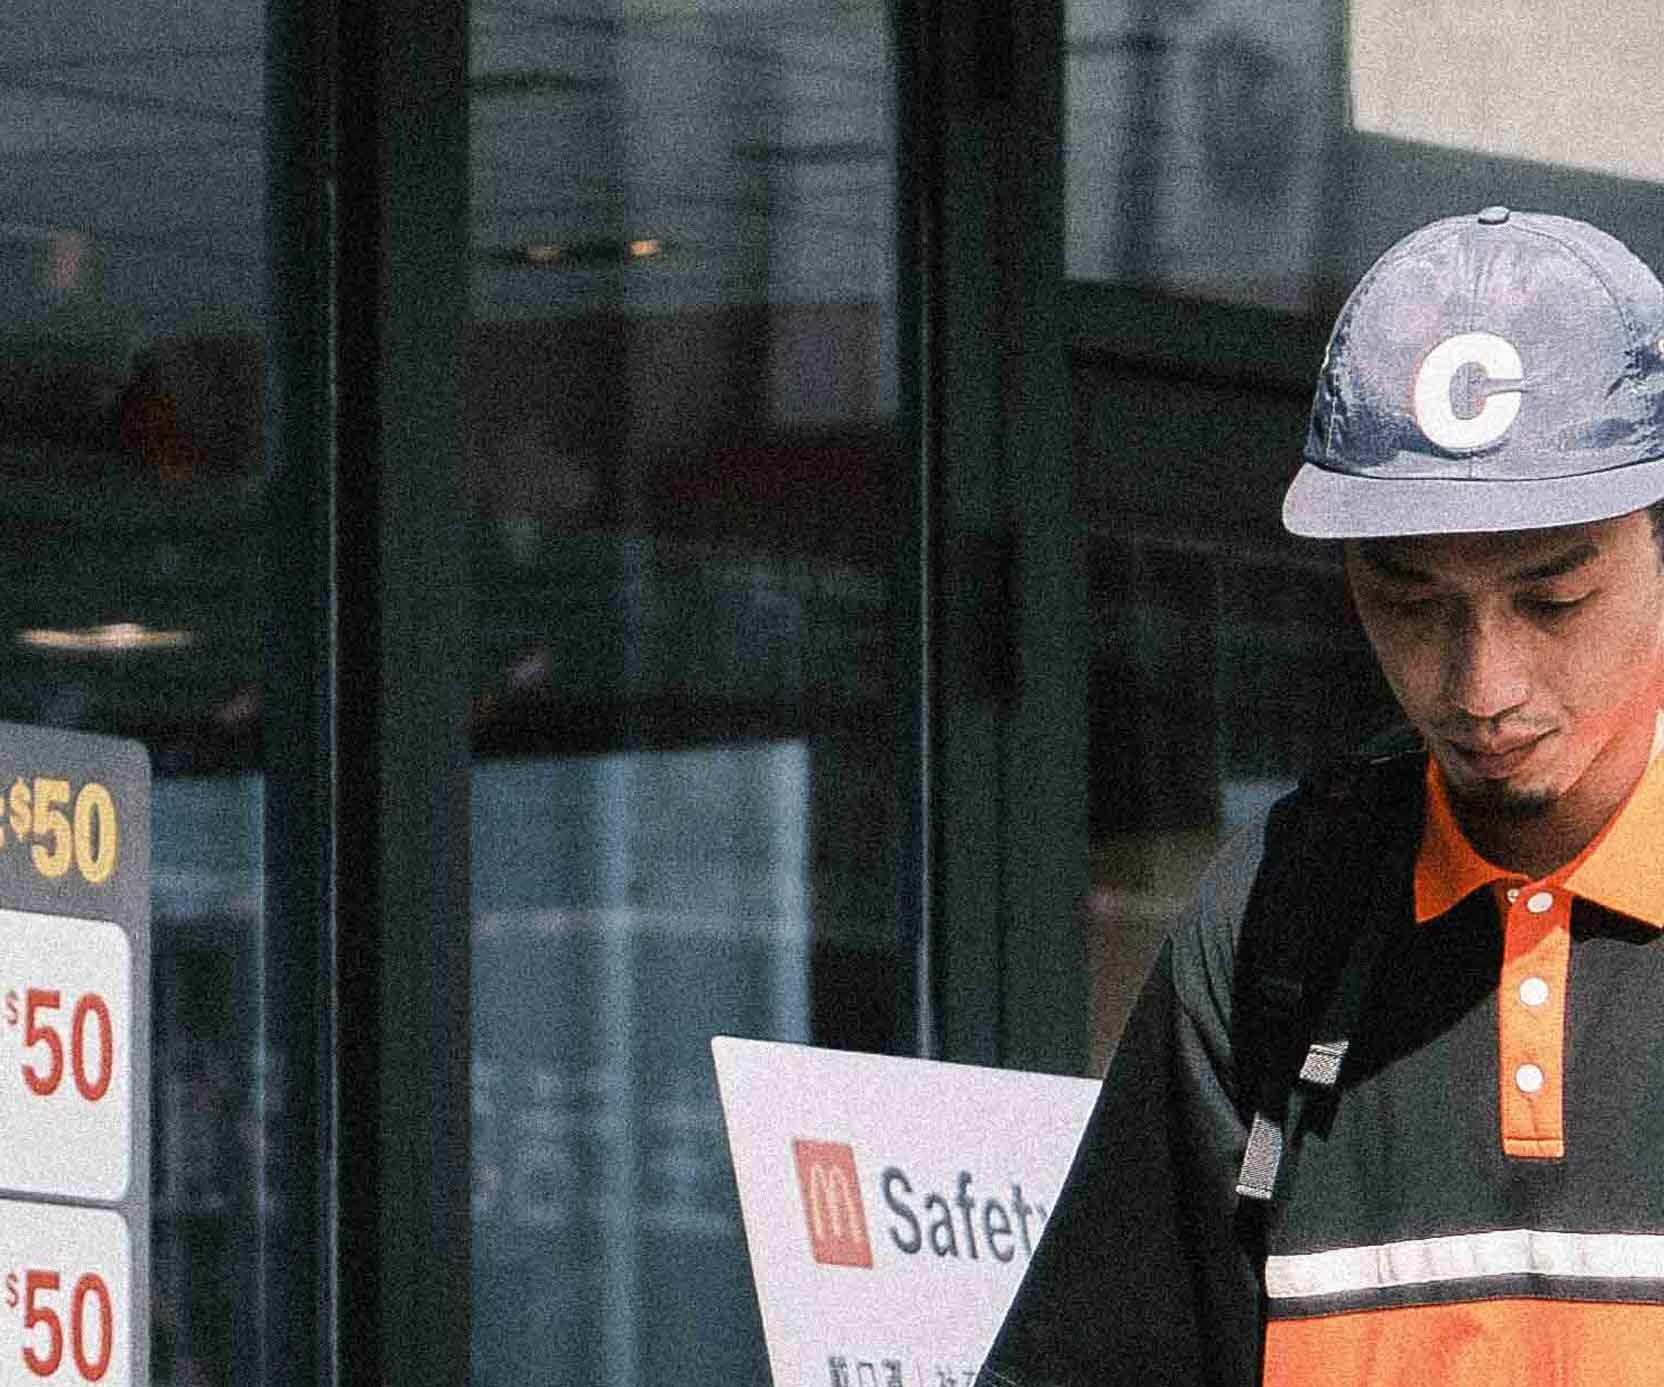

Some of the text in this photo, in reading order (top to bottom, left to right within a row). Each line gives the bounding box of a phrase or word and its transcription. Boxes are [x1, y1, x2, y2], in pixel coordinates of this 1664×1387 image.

[1415, 331, 1524, 449] C
[9, 775, 117, 884] $50
[4, 987, 113, 1101] $50
[5, 1268, 113, 1382] $50
